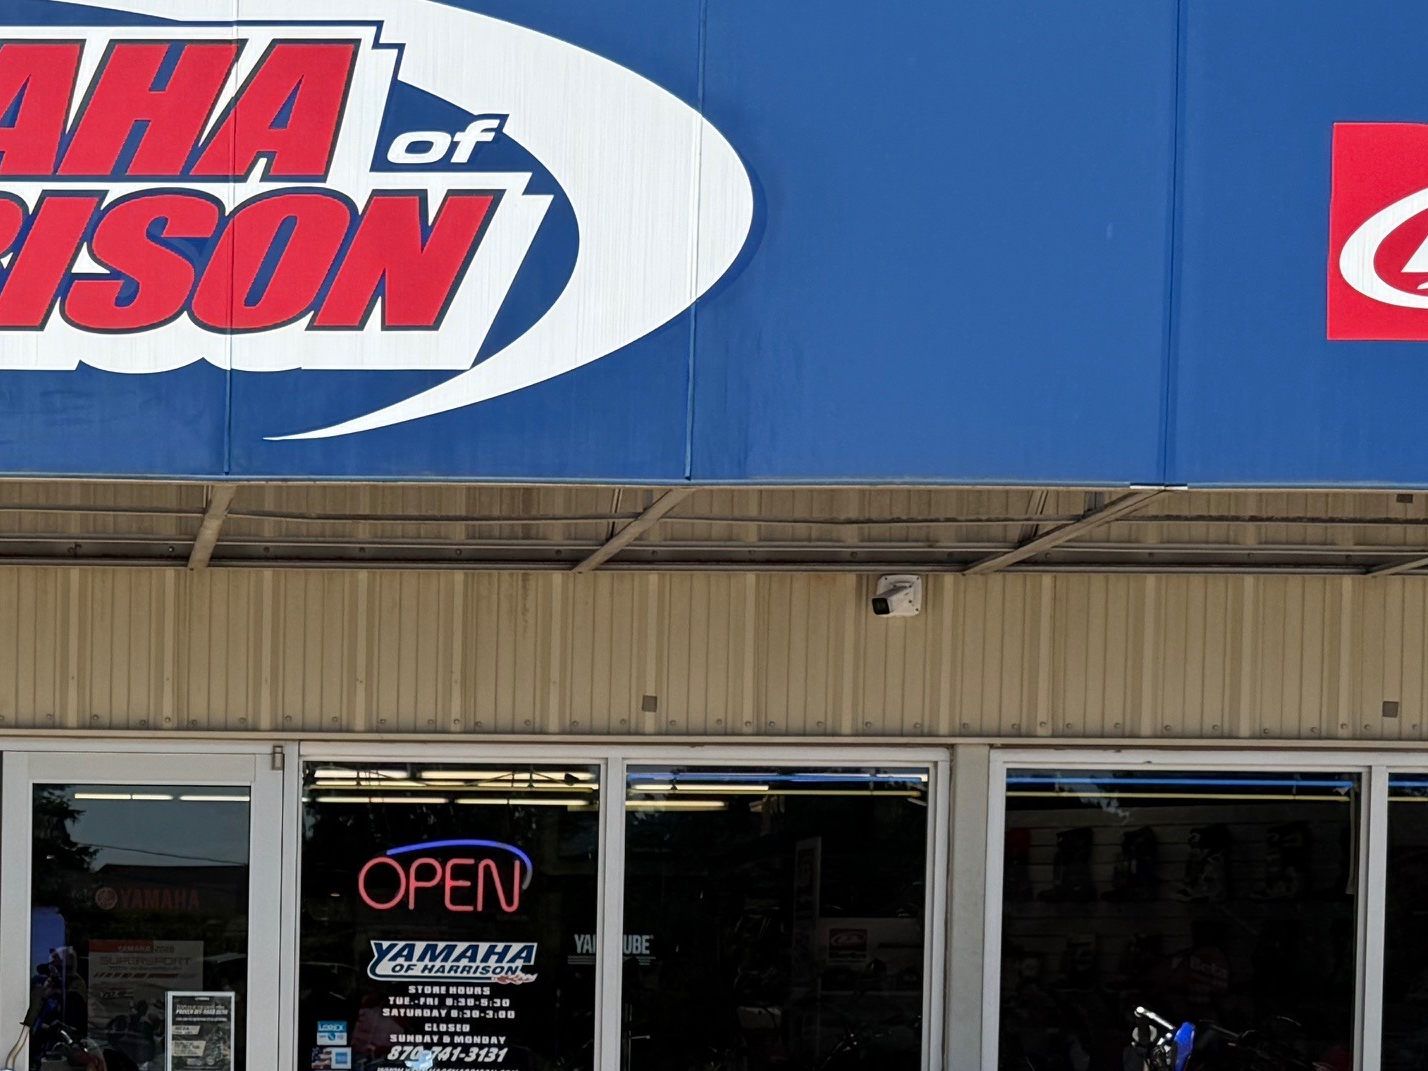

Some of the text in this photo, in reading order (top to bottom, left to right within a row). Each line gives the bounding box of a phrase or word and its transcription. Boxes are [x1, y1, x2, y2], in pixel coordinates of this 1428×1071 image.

[388, 114, 501, 166] of
[358, 855, 521, 913] OPEN
[119, 887, 201, 912] YAMAHA
[371, 942, 535, 964] YAMAHA
[391, 964, 520, 976] OF HARRISON
[408, 986, 491, 995] STORE HOURS
[382, 1008, 447, 1018] SATURDAY
[425, 1023, 470, 1032] CLOSED
[390, 1034, 439, 1043] SUNDAY
[454, 1035, 507, 1045] MONDAY
[387, 1045, 509, 1063] 870741-3131
